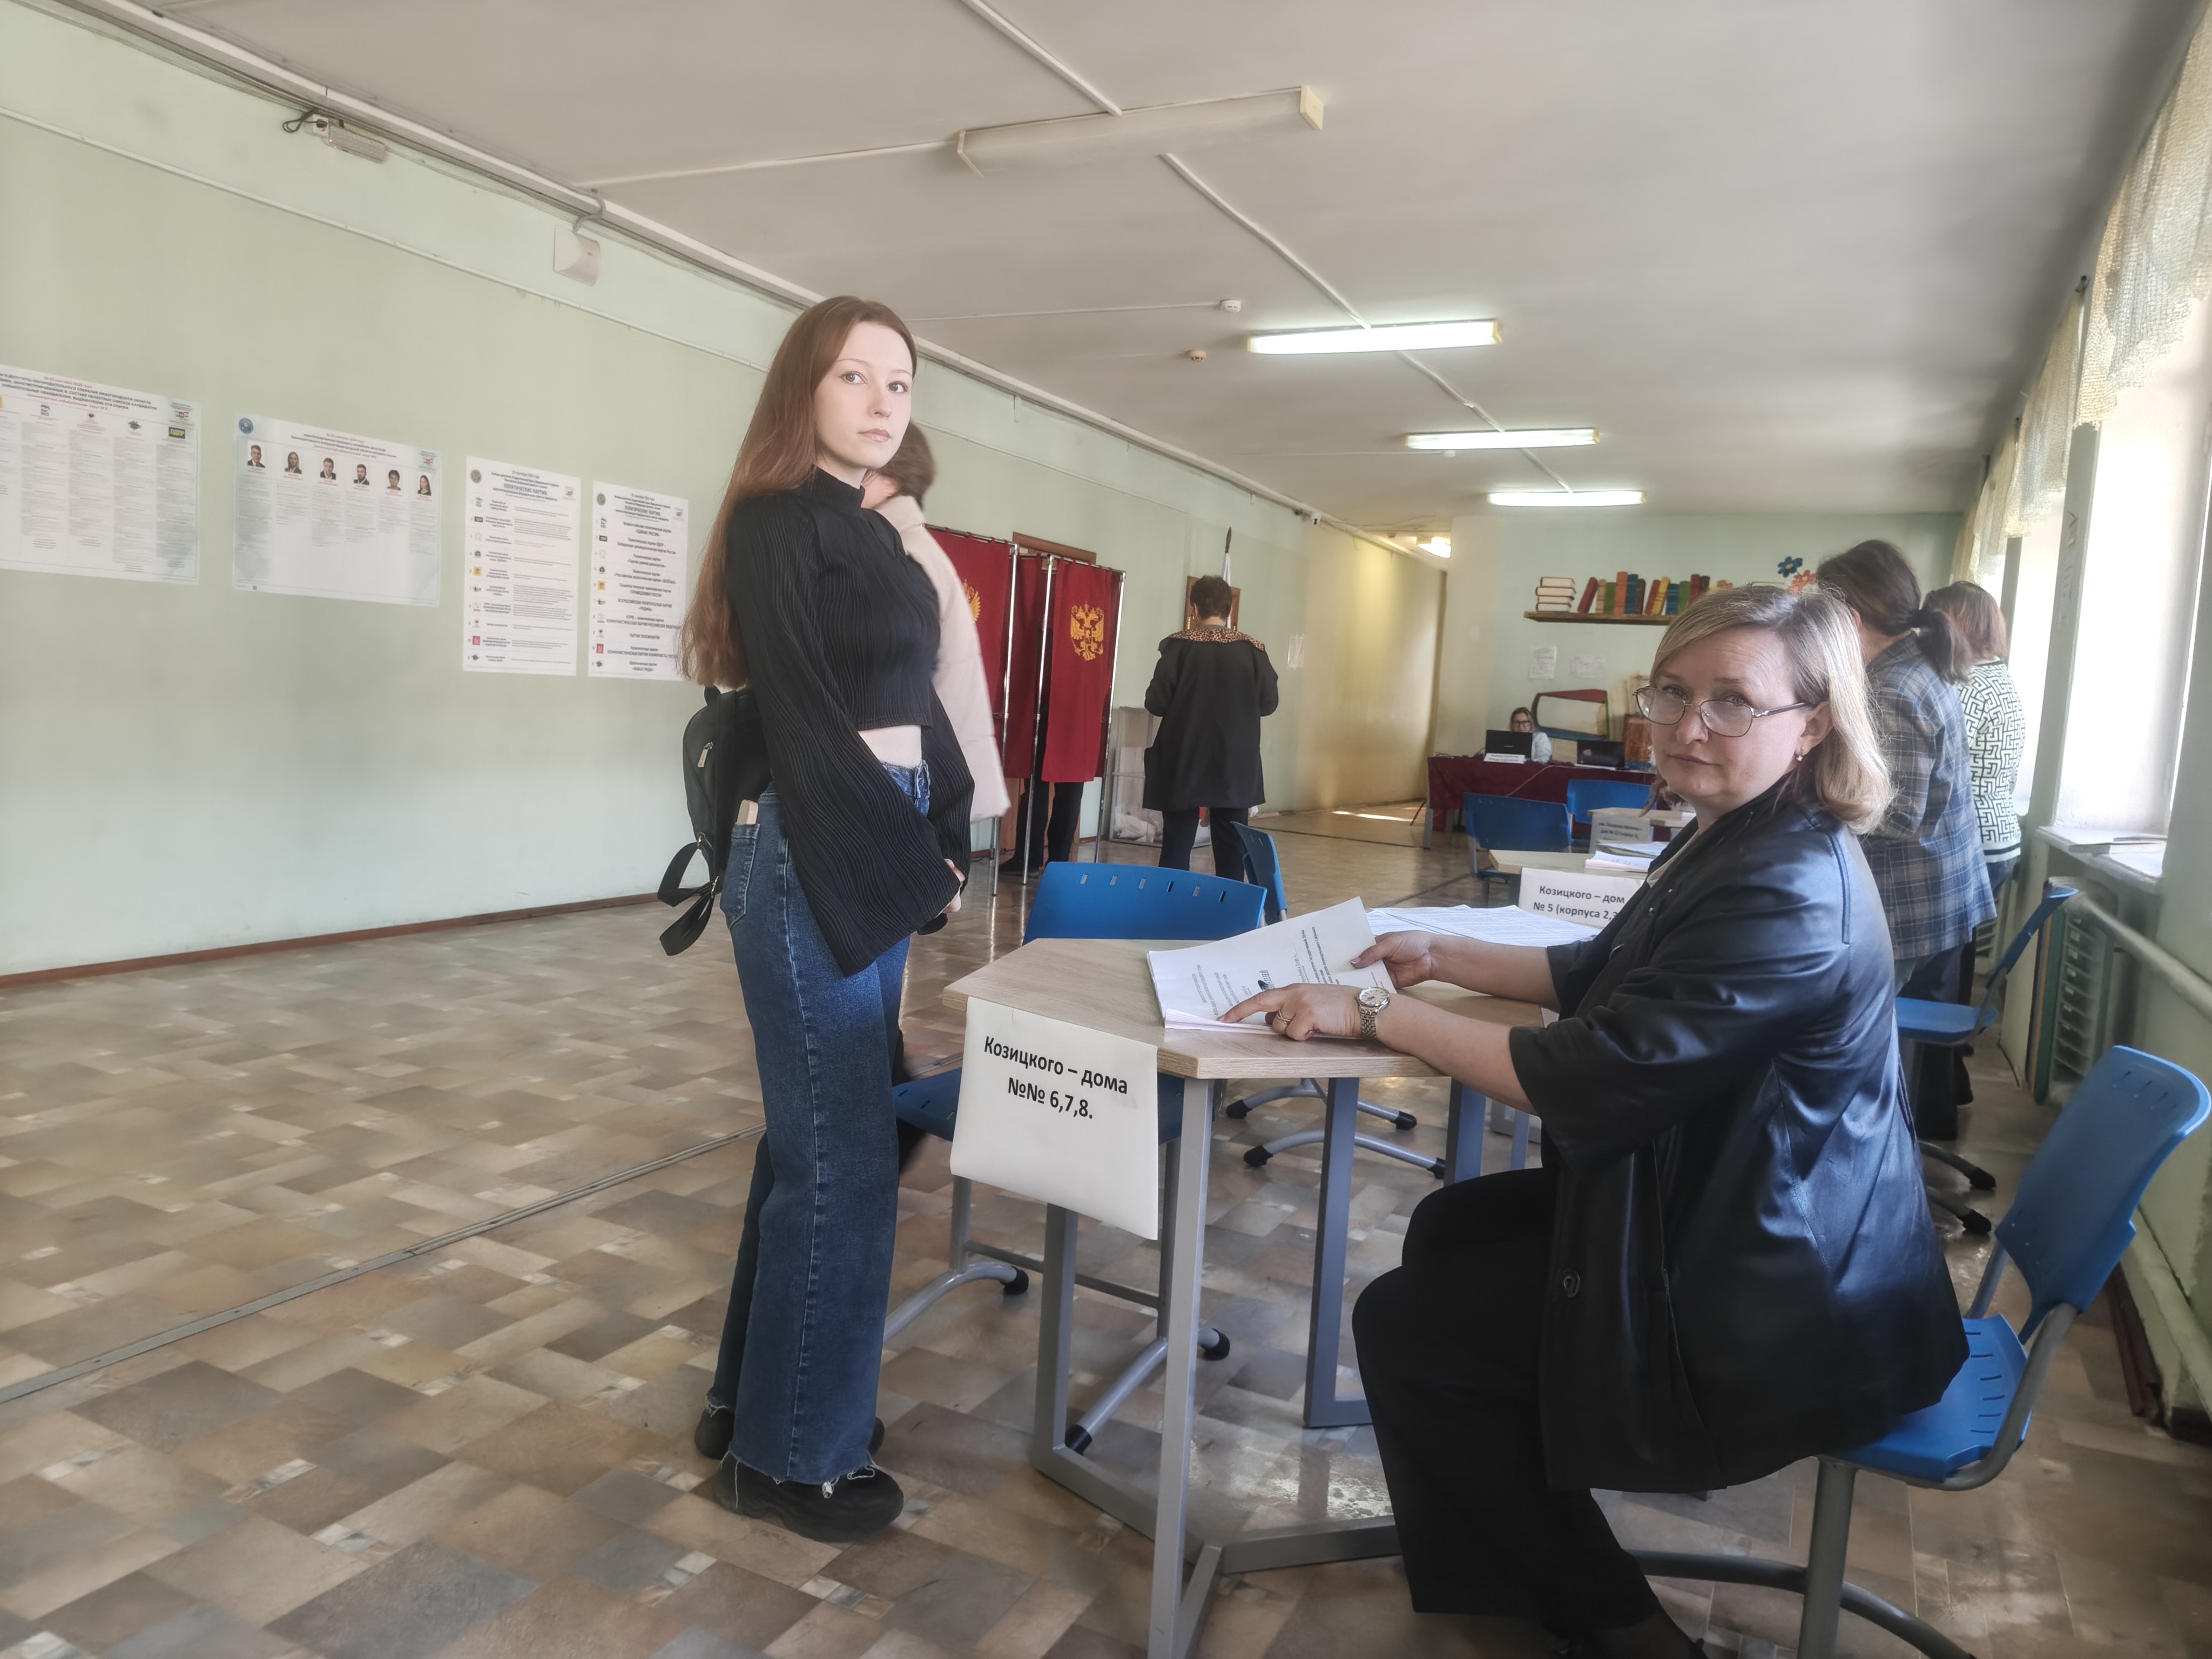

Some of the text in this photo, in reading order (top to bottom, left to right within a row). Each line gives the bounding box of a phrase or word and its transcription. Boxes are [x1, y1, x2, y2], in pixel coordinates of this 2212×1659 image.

[170, 428, 185, 436] ЛДПР
[504, 483, 531, 493] ПОЛИТИЧЕСКИЕ
[1539, 886, 1591, 900] Козицкого
[1602, 895, 1625, 903] дом
[1533, 902, 1545, 911] №
[1548, 903, 1553, 912] 5
[1556, 904, 1600, 919] (корпуса
[984, 1036, 1063, 1075] Козицкого
[1081, 1070, 1128, 1094] дома
[1008, 1077, 1093, 1119] №№ 6,7,8.
